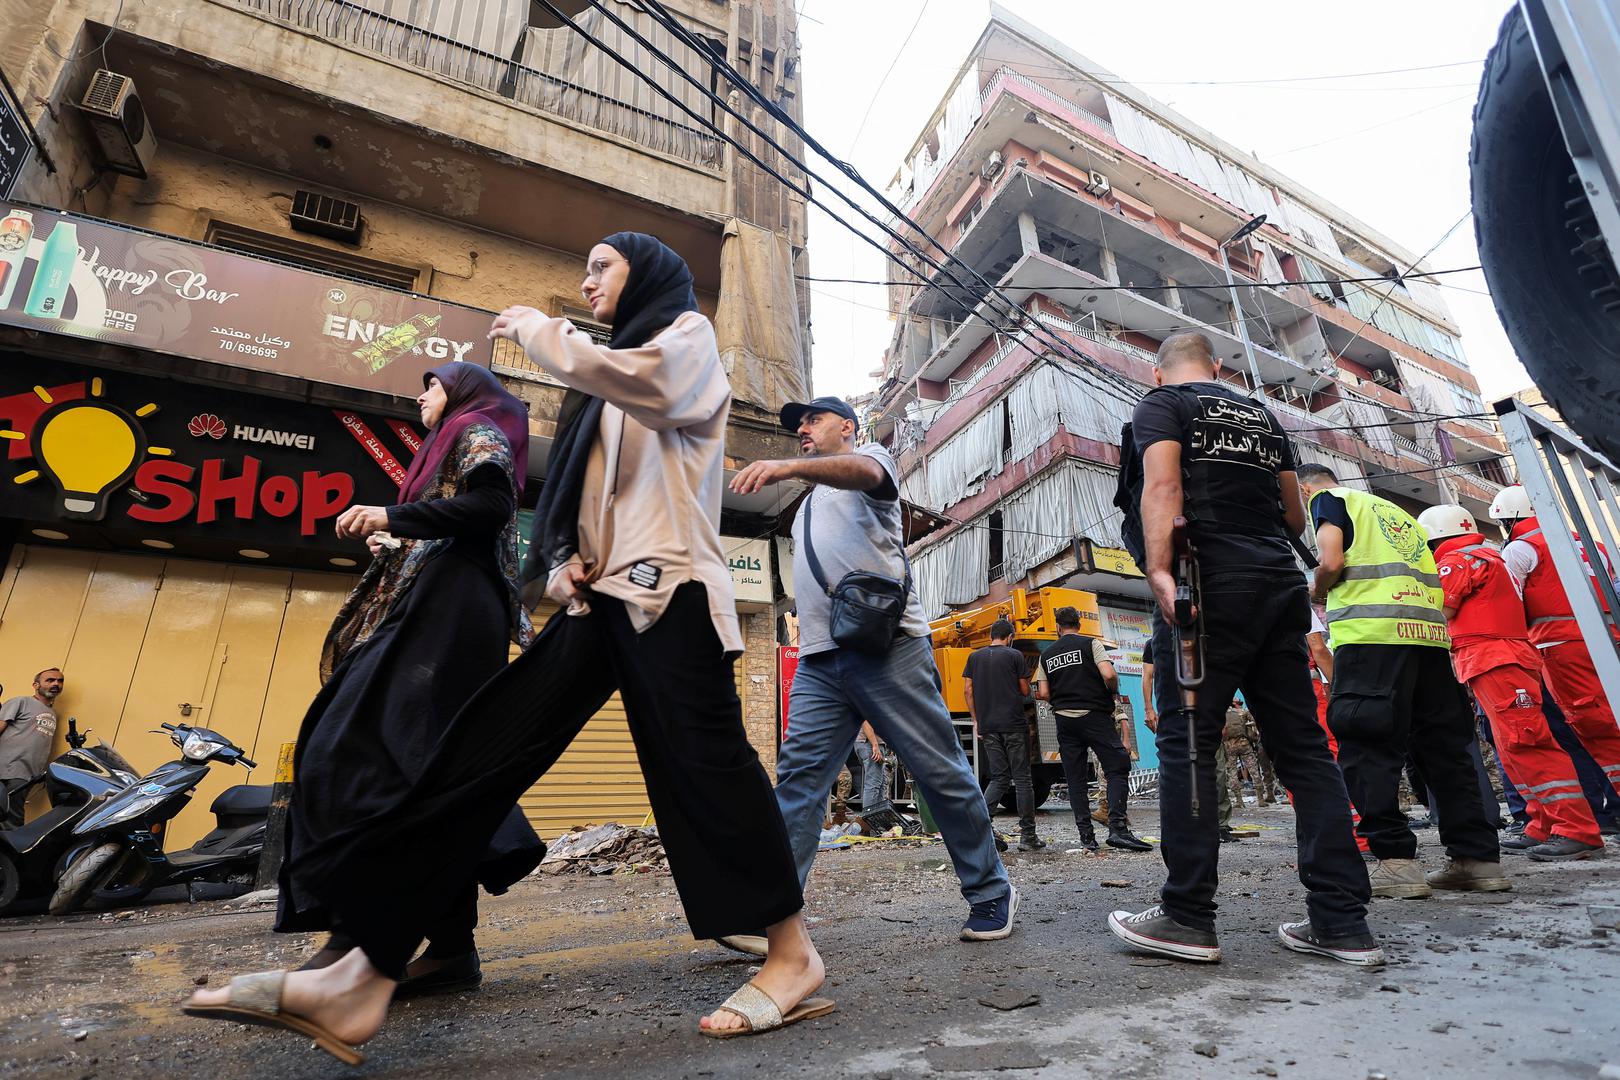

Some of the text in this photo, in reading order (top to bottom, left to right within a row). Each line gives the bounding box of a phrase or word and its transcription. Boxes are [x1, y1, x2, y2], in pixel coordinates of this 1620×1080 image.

[165, 269, 239, 304] Bar
[210, 326, 291, 349] وكيل معتمد
[219, 339, 278, 359] 70/695695
[1207, 400, 1266, 424] الجيش
[233, 424, 315, 450] HUAWEI
[1191, 430, 1252, 456] المخابرات
[366, 438, 384, 459] جملة
[1391, 584, 1425, 603] المدني
[1397, 622, 1451, 643] CIVIL DEFE
[1048, 652, 1079, 670] POLICE
